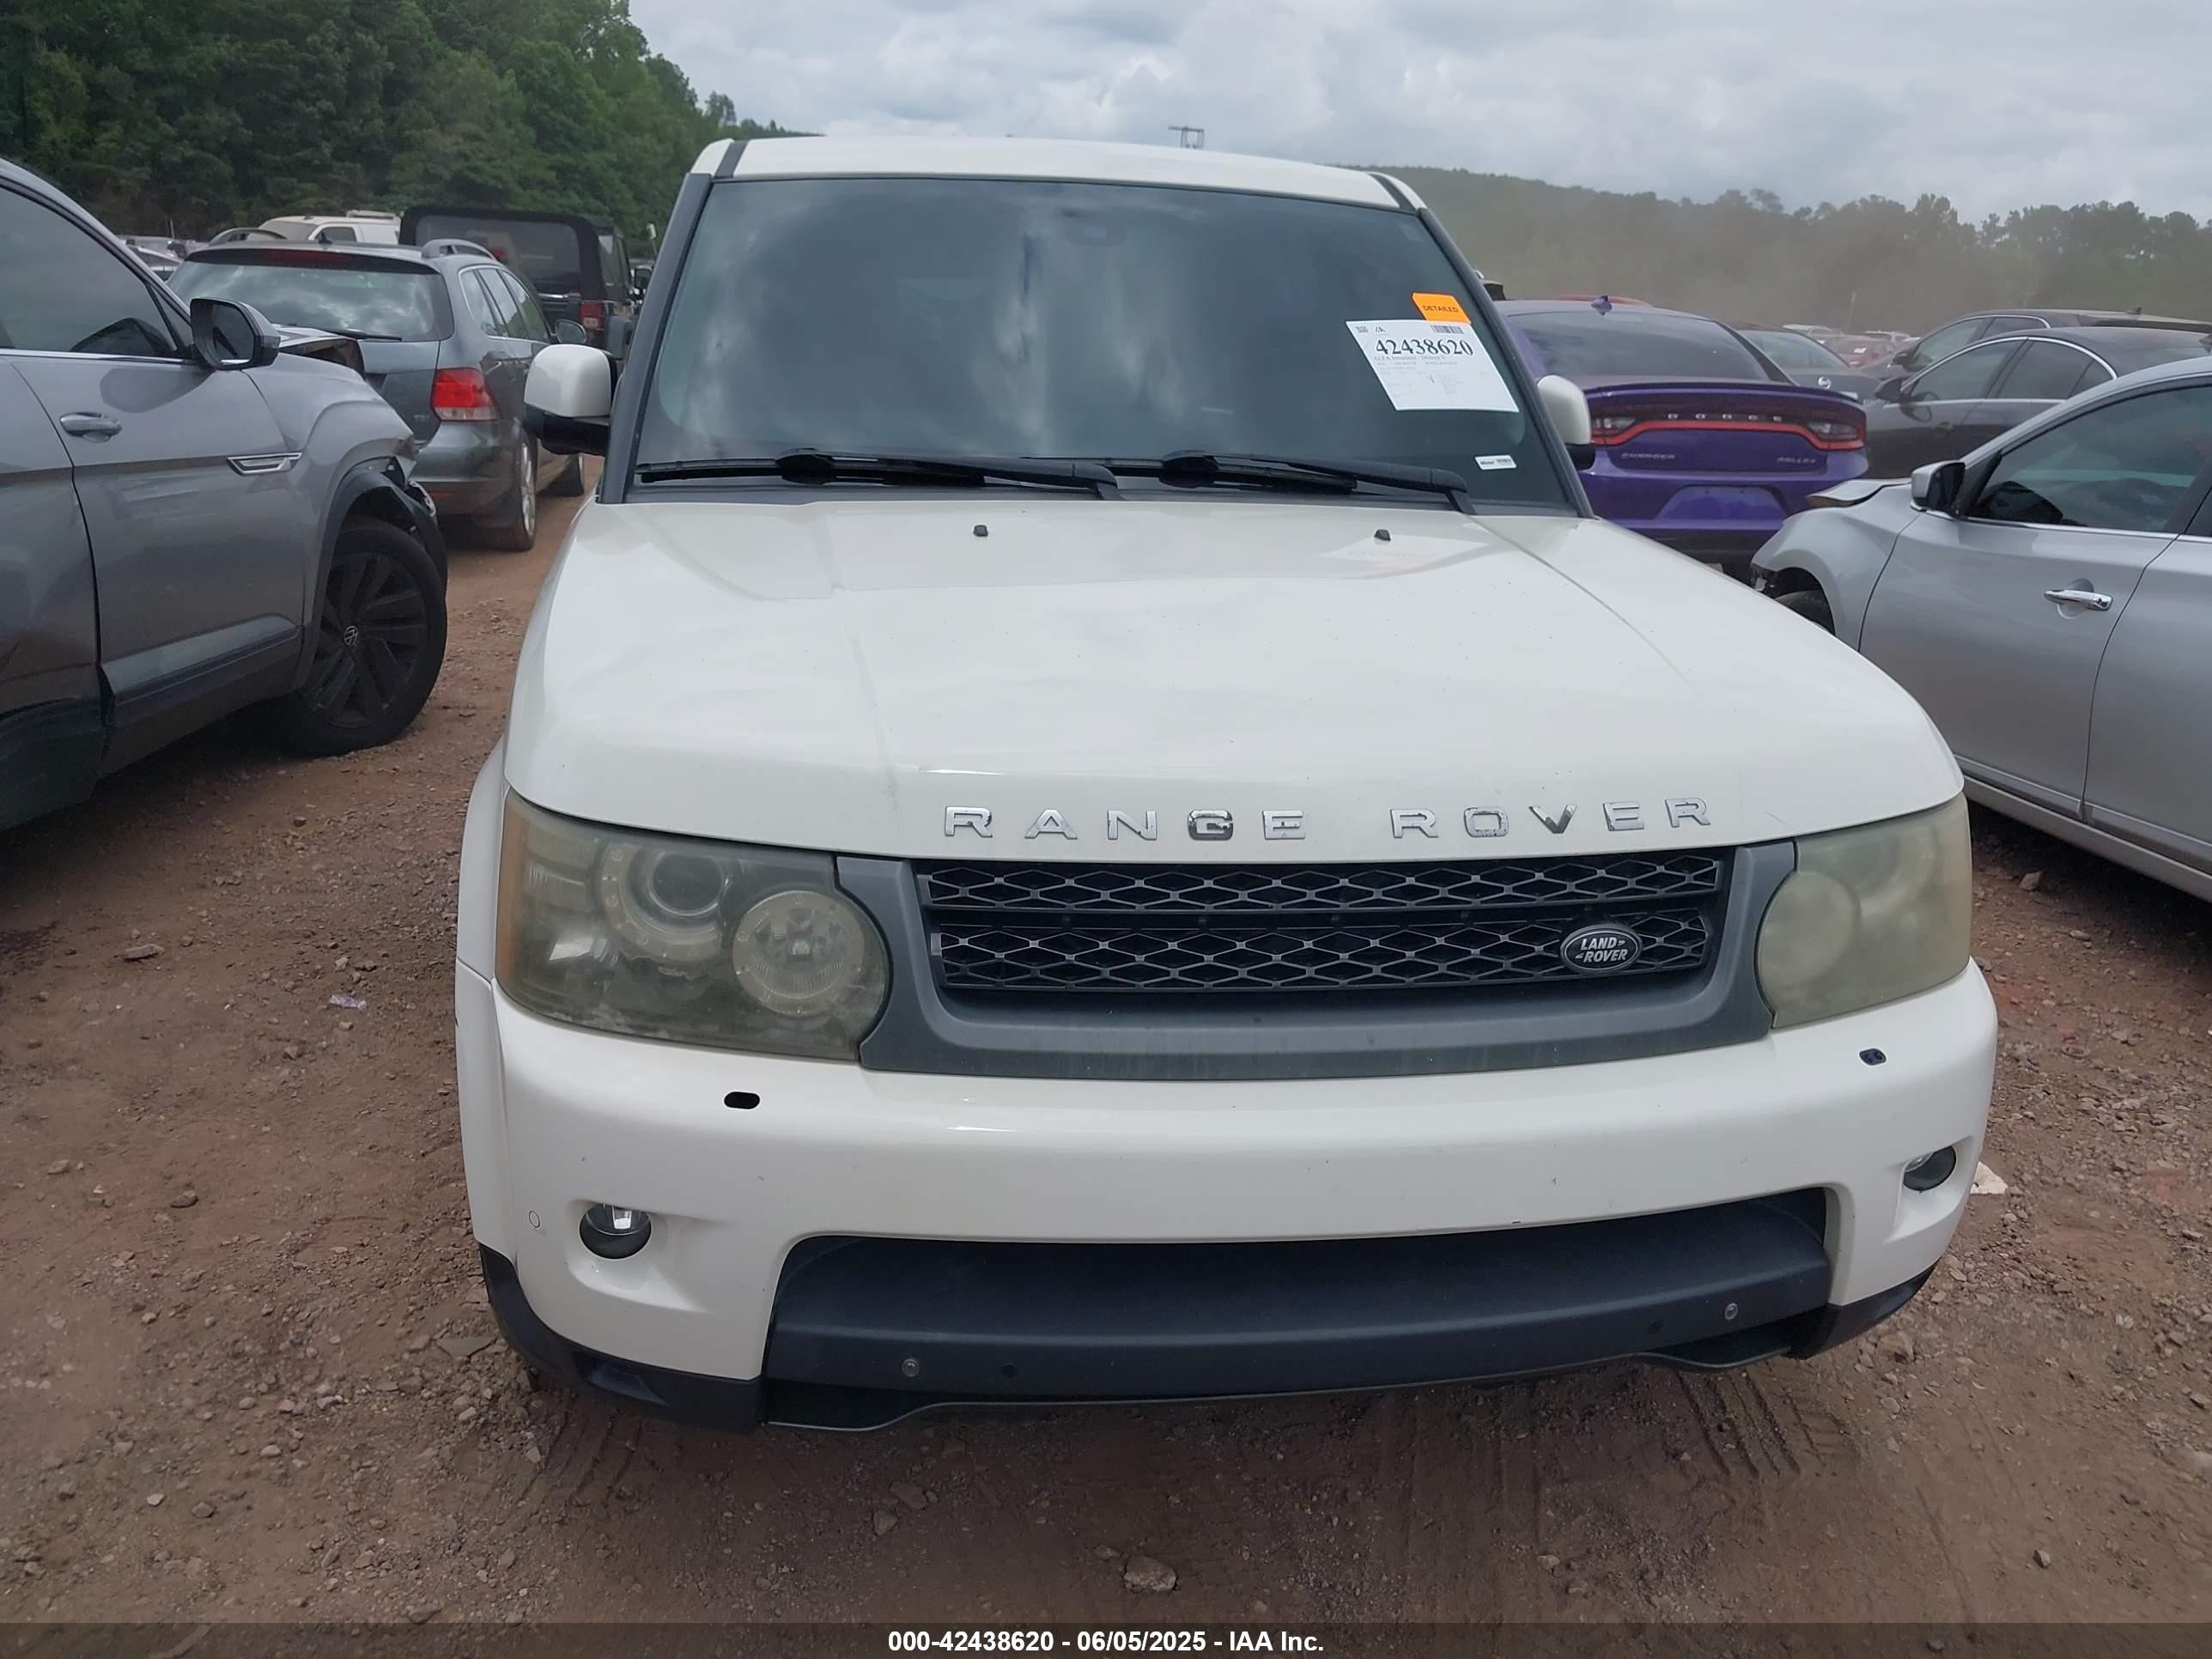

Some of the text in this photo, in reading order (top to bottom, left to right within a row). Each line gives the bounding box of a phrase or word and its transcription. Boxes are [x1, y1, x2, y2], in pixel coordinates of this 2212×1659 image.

[1422, 305, 1459, 313] DETAILED
[1376, 338, 1474, 356] 42438620
[945, 797, 1711, 841] RANGE ROVER
[1580, 937, 1618, 951] LAND
[1583, 948, 1629, 963] ROVER
